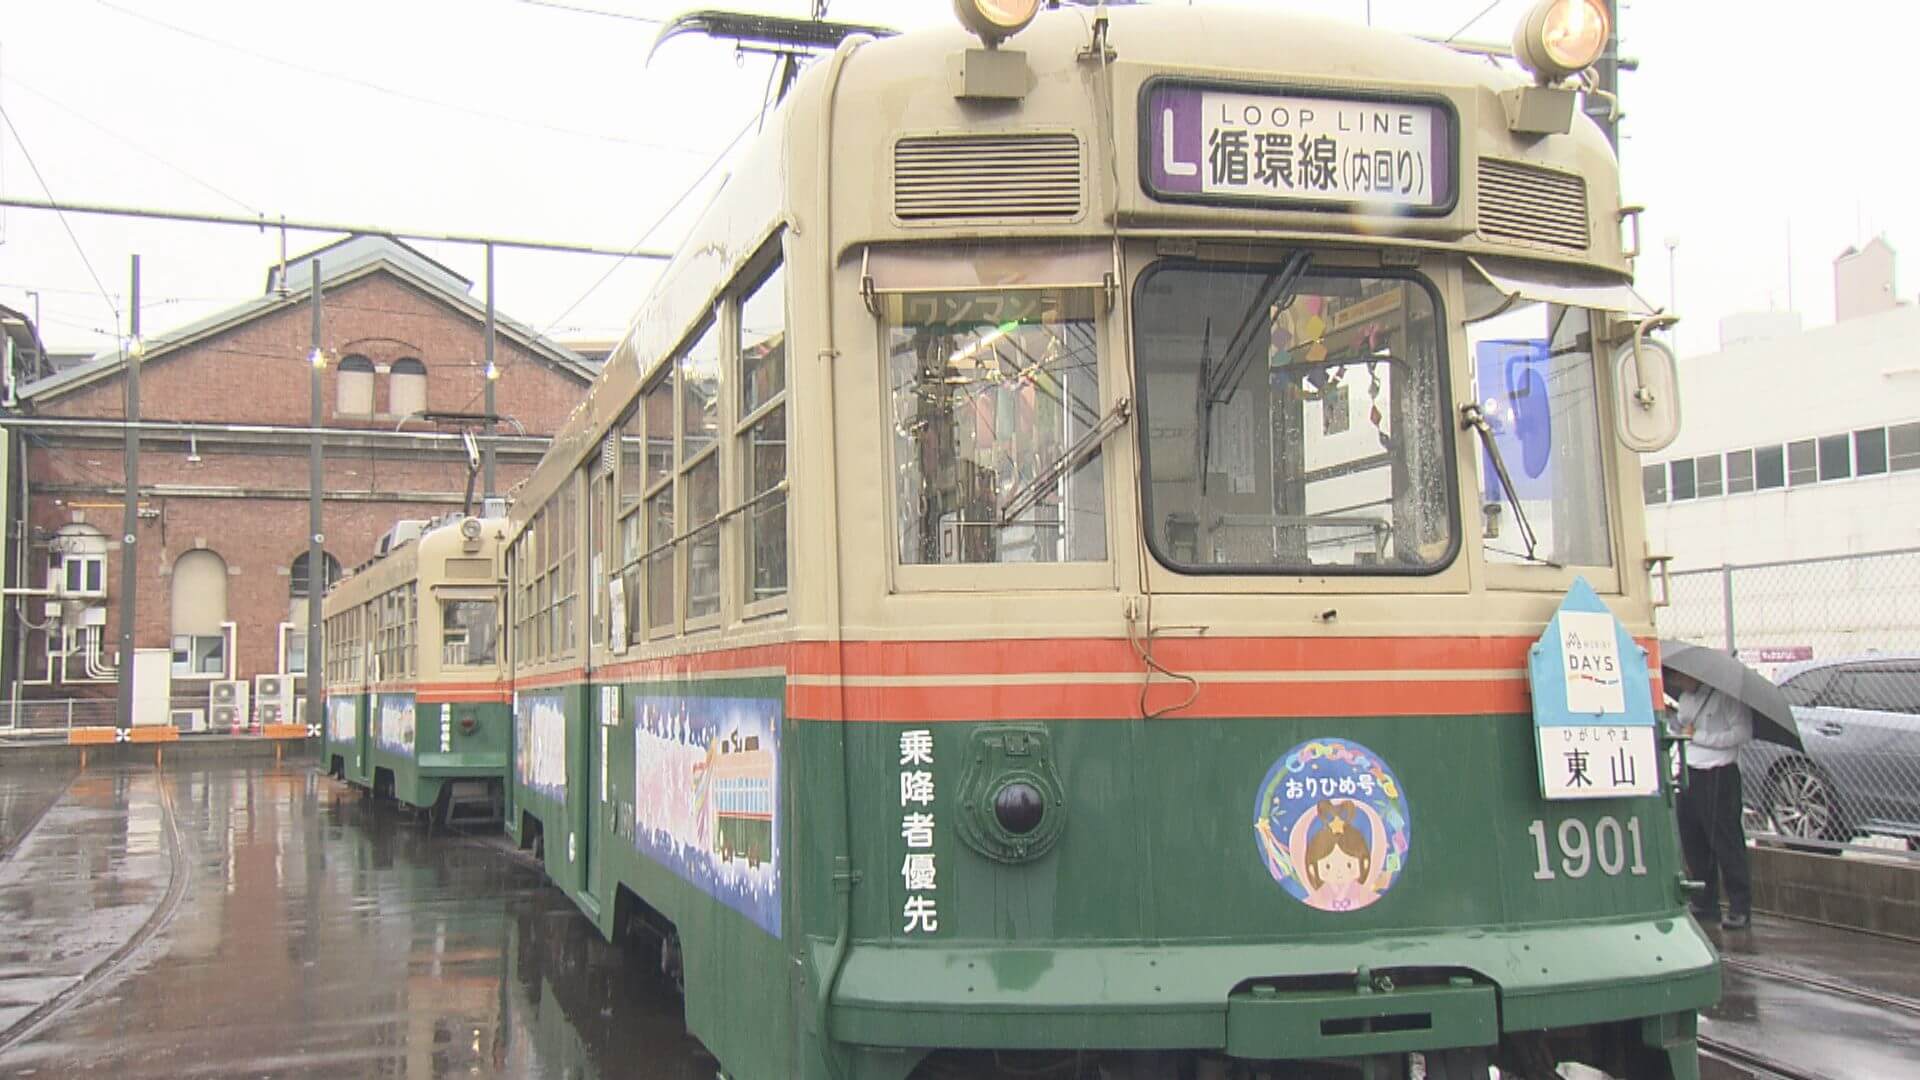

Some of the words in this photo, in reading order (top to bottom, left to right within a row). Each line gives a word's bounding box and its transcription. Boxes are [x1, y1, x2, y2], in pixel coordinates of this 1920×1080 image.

[1163, 108, 1198, 176] L
[1221, 103, 1315, 128] LOOP
[1338, 111, 1413, 135] LINE
[1569, 654, 1614, 672] DAYS
[1285, 773, 1375, 800] おりひめ号
[899, 729, 938, 932] 乗降者優先
[1528, 815, 1648, 880] 1901
